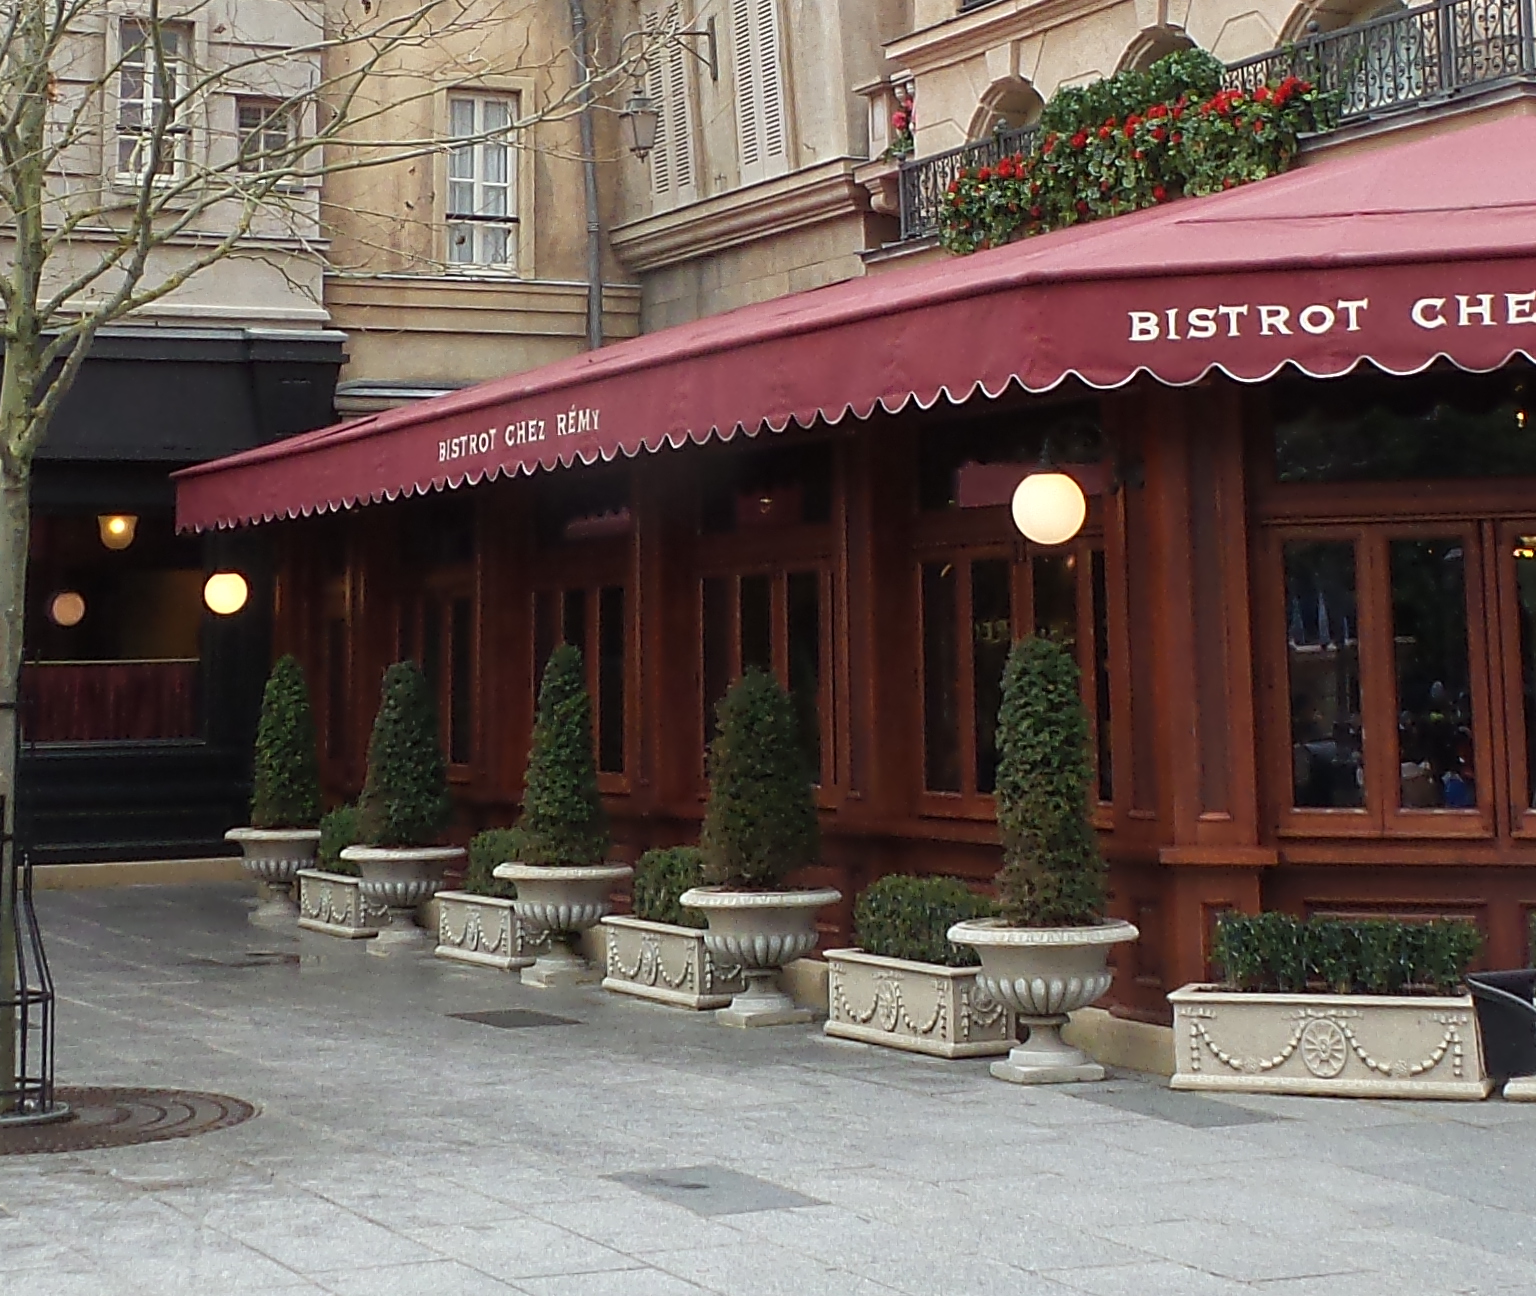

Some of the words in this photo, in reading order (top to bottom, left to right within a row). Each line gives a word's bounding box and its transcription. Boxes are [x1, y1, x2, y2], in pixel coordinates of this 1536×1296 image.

[1128, 297, 1368, 342] BISTROT
[438, 429, 497, 462] BISTROT
[505, 420, 546, 446] CHEZ
[557, 405, 600, 435] RÉMY
